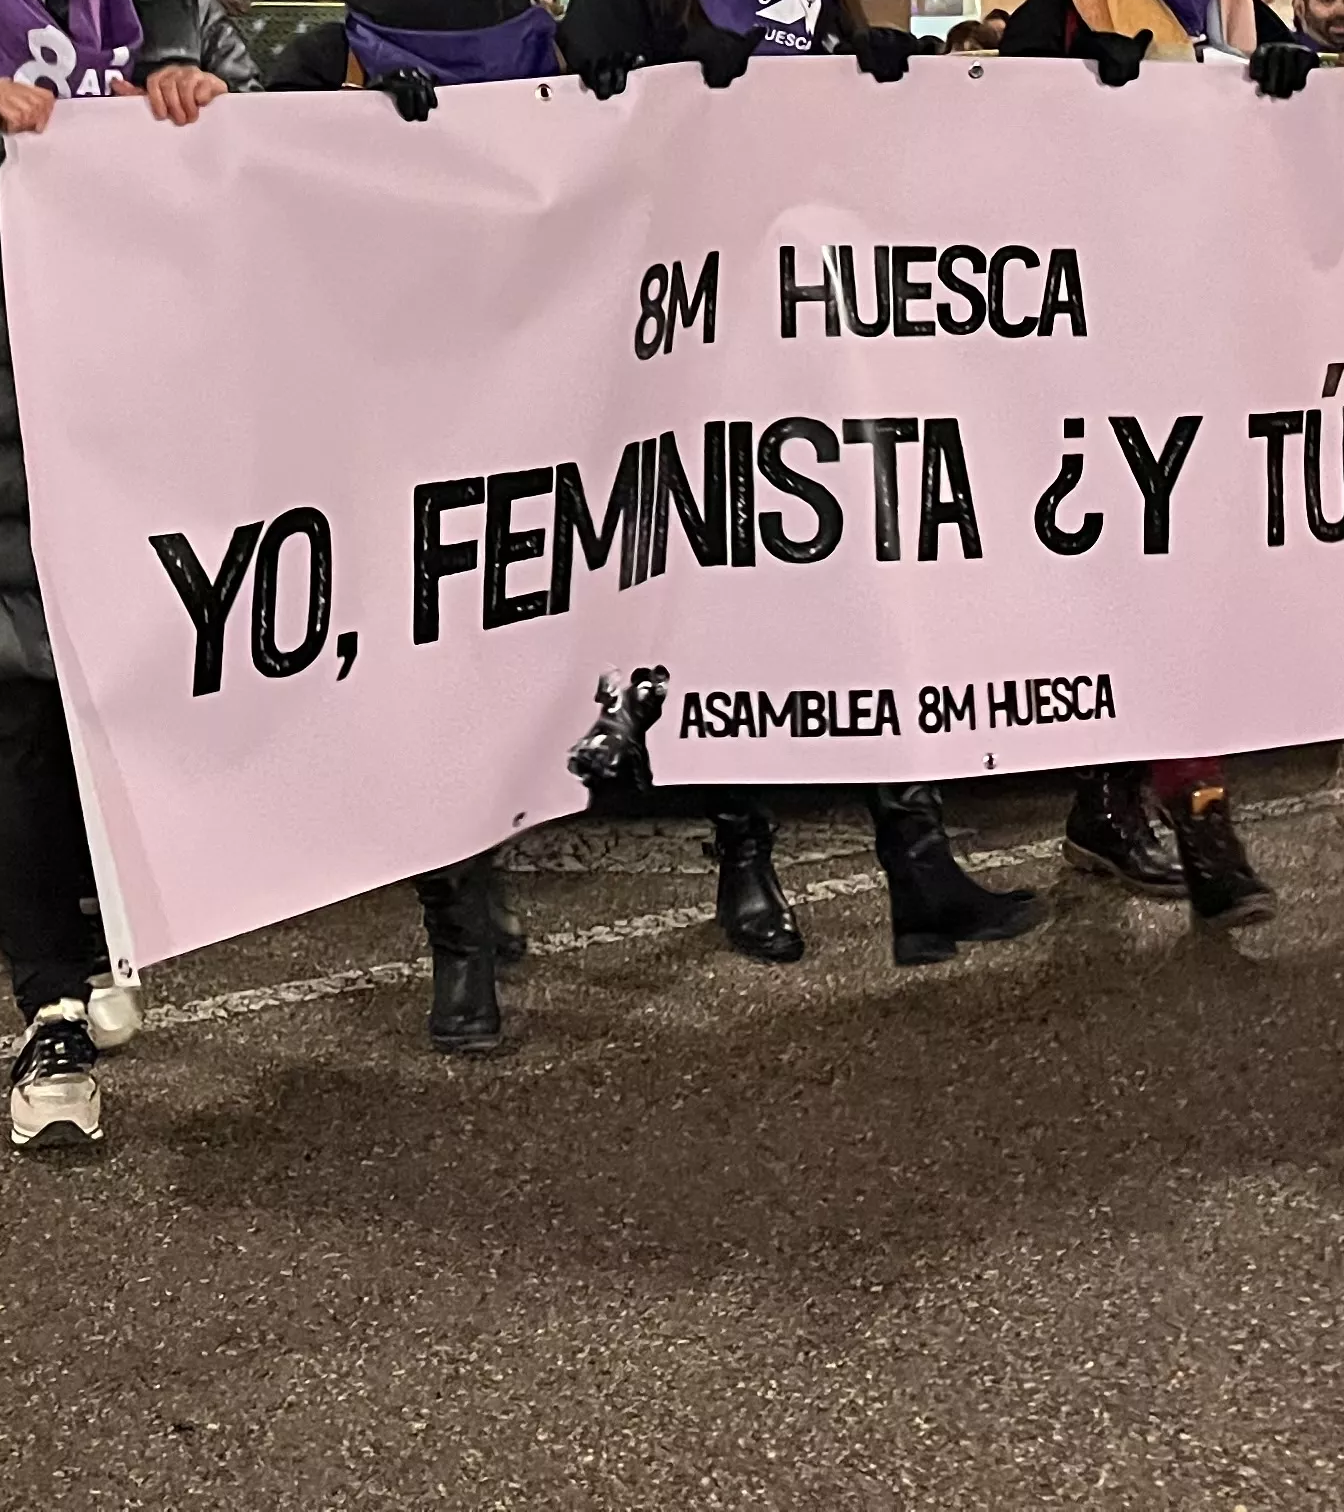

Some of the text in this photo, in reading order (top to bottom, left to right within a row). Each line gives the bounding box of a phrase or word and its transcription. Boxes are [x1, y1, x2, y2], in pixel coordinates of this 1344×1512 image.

[764, 29, 812, 51] UESC
[634, 244, 1088, 361] 8M HUESCA
[148, 506, 358, 697] YO,
[413, 417, 983, 646] FEMINISTA
[1034, 415, 1203, 555] ¿Y
[679, 673, 1115, 739] ASAMBLEA 8M HUESCA
